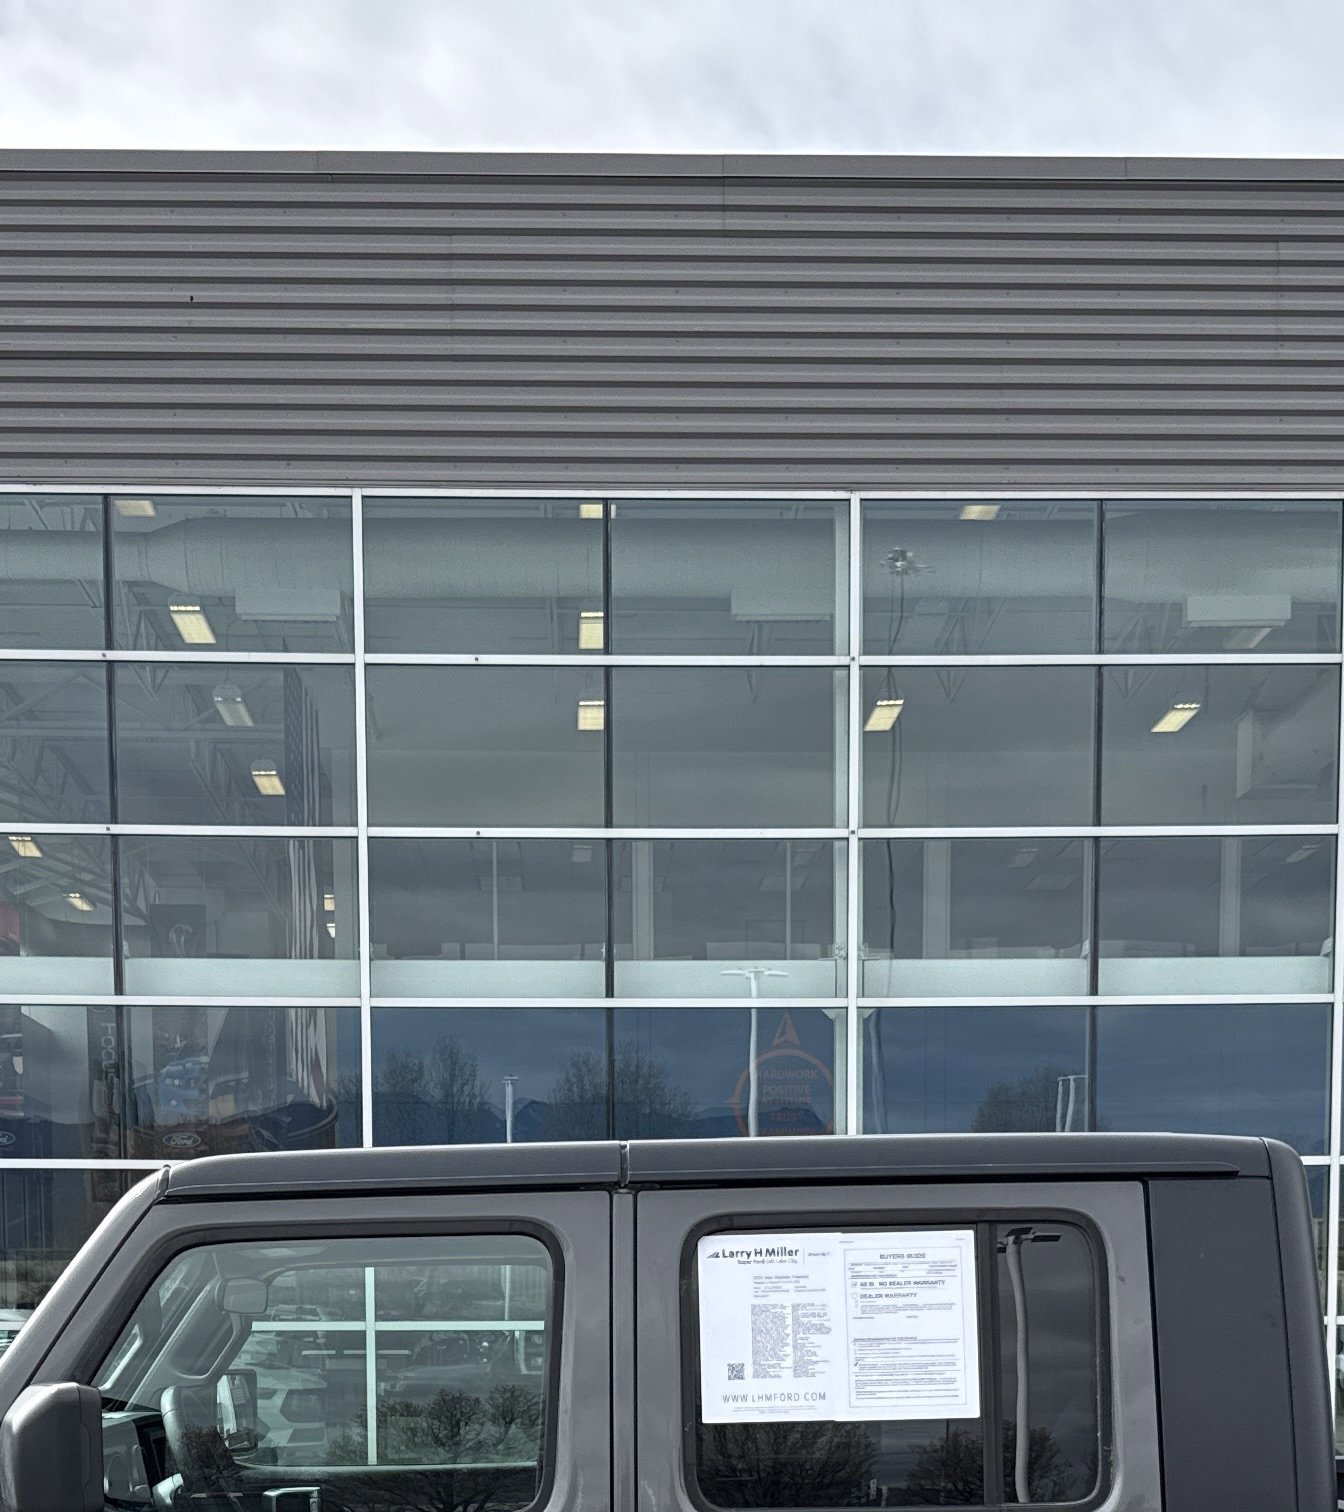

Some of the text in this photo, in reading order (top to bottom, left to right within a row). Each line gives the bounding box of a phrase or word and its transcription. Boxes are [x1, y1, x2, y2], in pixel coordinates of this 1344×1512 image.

[721, 1248, 752, 1259] Larry
[754, 1247, 763, 1257] H
[765, 1246, 799, 1257] Miller
